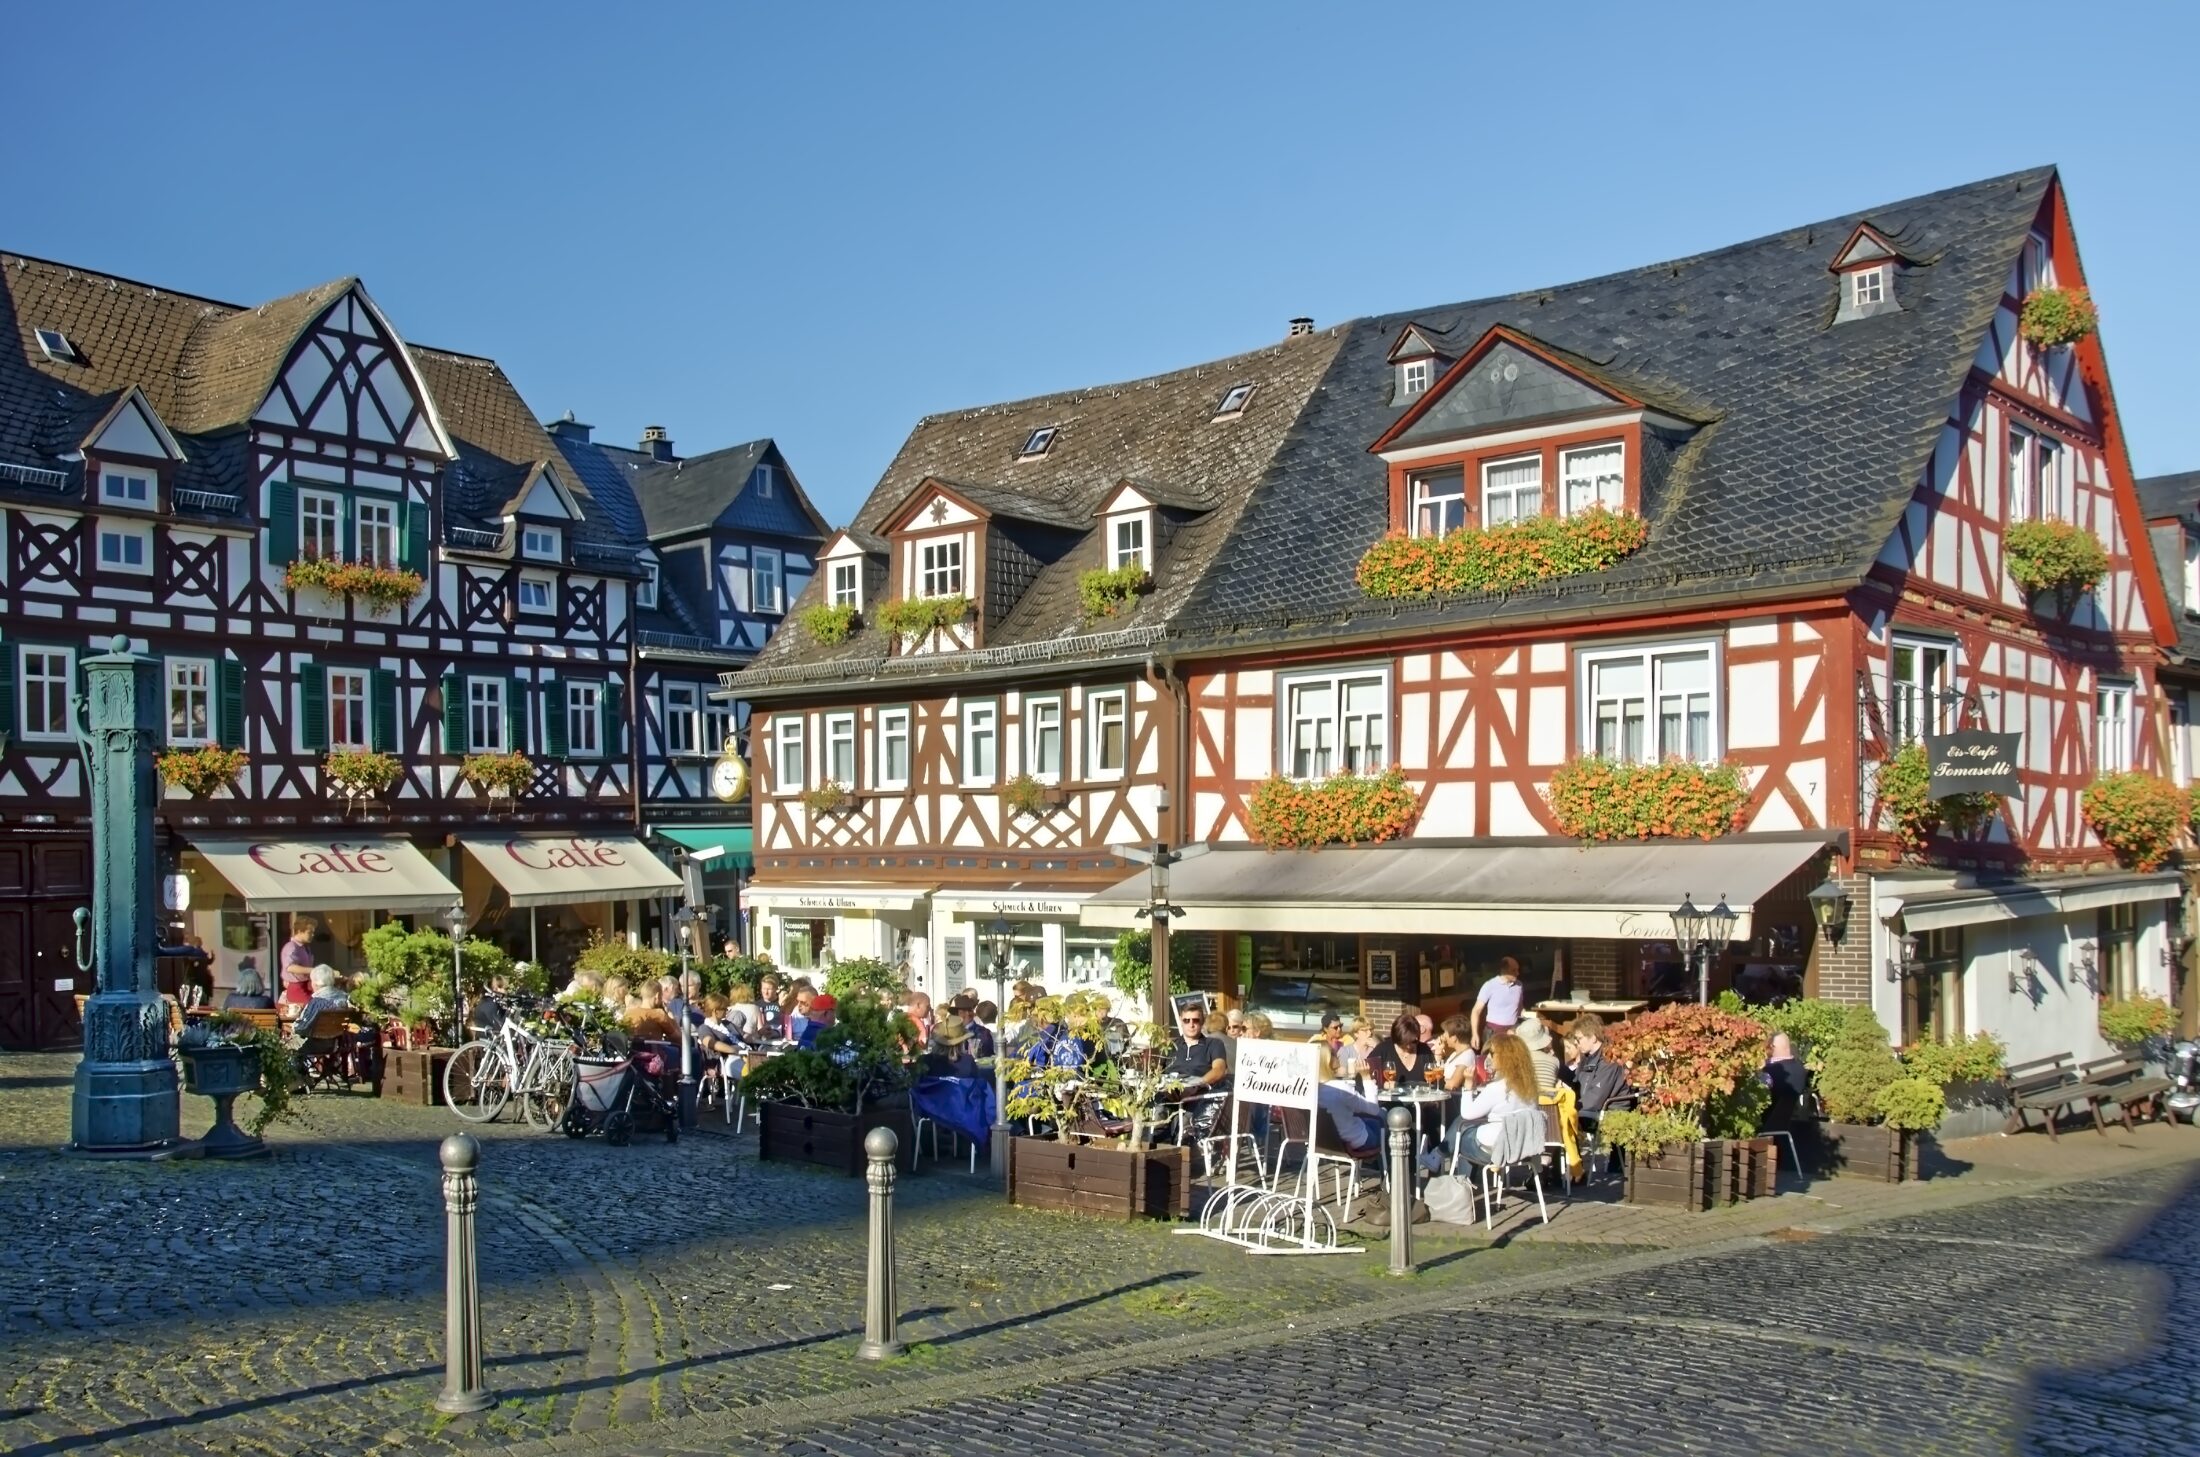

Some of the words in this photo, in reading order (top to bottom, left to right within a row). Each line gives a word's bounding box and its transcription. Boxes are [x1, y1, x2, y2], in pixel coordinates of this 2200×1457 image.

[1946, 744, 1999, 760] Eis-Café
[1933, 761, 2013, 777] Tomaselli
[1809, 782, 1817, 796] 7
[248, 843, 394, 875] Café
[505, 836, 626, 870] Café
[1028, 901, 1035, 912] &
[1242, 1070, 1309, 1097] Tomaselli
